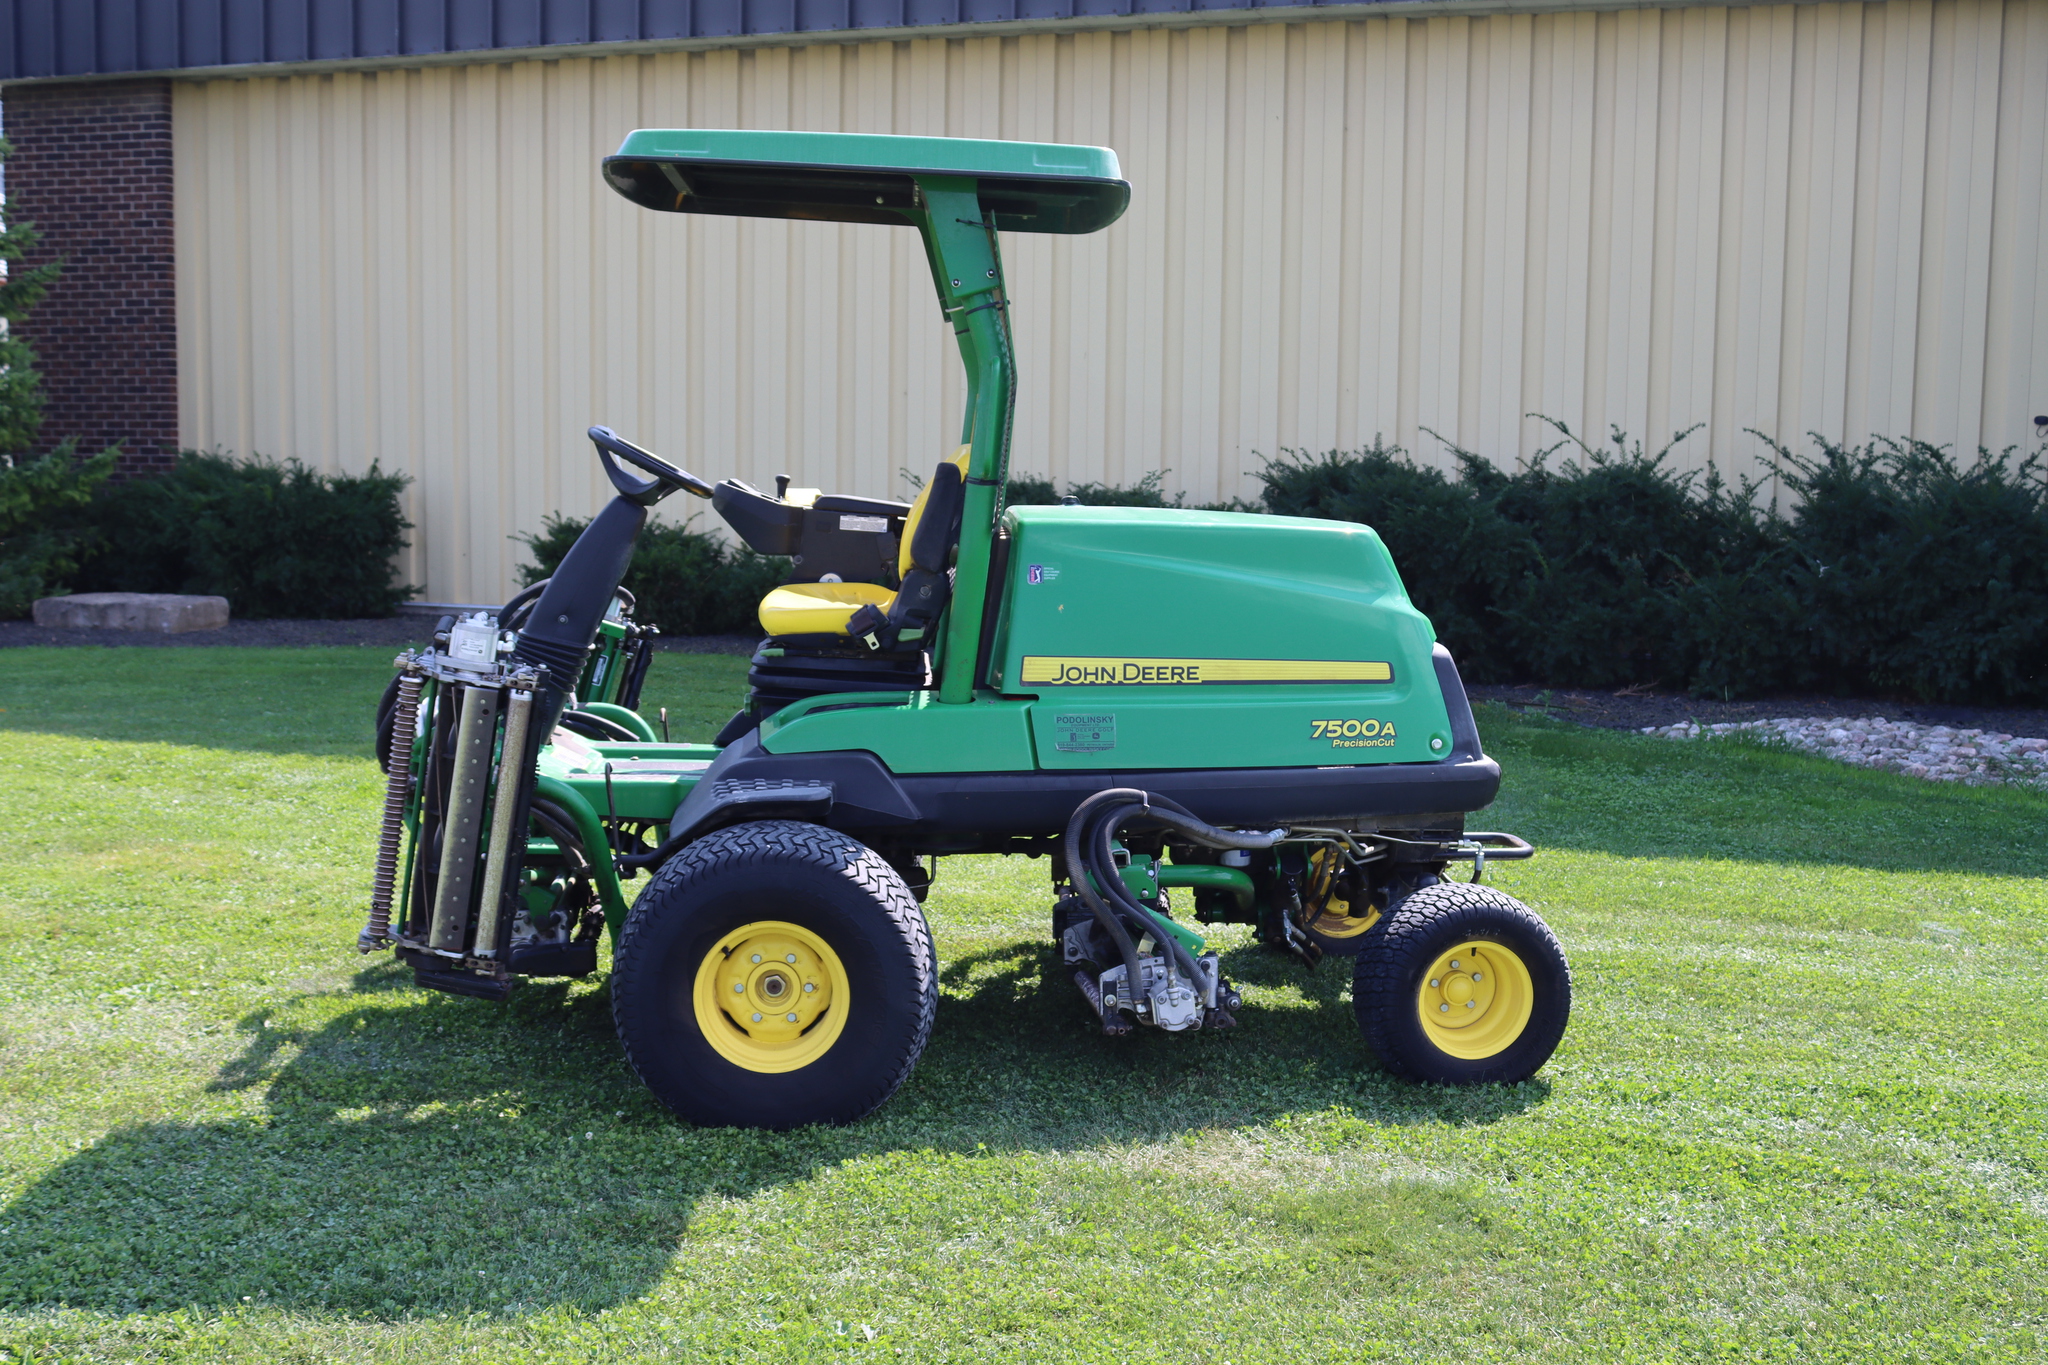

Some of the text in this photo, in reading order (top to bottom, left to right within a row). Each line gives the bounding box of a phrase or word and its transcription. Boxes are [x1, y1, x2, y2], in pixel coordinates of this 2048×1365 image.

[1051, 663, 1200, 682] JOHN DEERE
[1332, 738, 1395, 748] PrecisionCut
